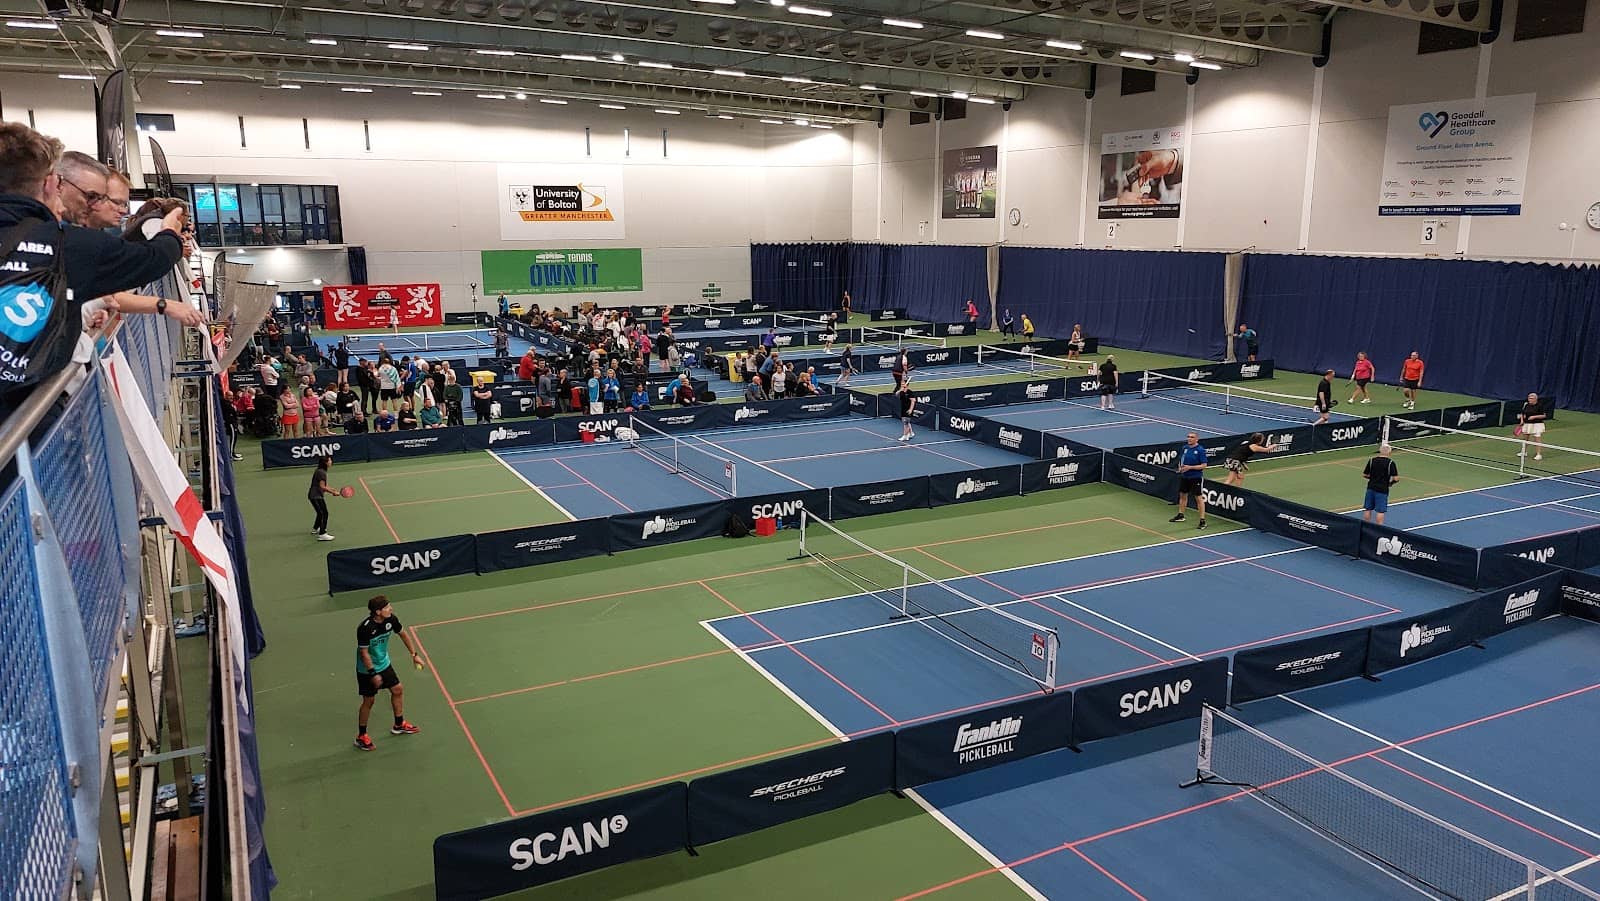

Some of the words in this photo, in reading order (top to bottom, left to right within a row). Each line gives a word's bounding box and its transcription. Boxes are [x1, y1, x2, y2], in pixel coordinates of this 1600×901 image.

[1451, 110, 1484, 120] Goodall
[1450, 118, 1496, 128] Healthcare
[1449, 128, 1476, 136] Group
[535, 189, 580, 200] University
[536, 200, 546, 209] of
[548, 200, 577, 209] Bolton
[1109, 225, 1114, 237] 2
[1425, 227, 1433, 241] 3
[17, 241, 54, 256] AREA
[529, 264, 576, 287] OWN
[583, 264, 599, 285] IT
[1047, 462, 1079, 478] Franklin
[1276, 512, 1329, 530] SKECHERS
[513, 534, 577, 549] SKECHERS
[370, 550, 431, 575] SCAN
[1400, 552, 1417, 561] SHOP
[1401, 549, 1438, 562] PICKLEBALL
[1503, 588, 1540, 615] Franklin
[1505, 607, 1533, 624] PICKLEBALL
[1420, 624, 1452, 638] PICKLEBALL
[1420, 635, 1435, 646] SHOP
[1034, 644, 1043, 656] 10
[1275, 651, 1342, 671] SKECHERS
[1290, 664, 1325, 676] PICKLEBALL
[1119, 681, 1182, 718] SCAN
[953, 716, 1023, 752] Franklin
[959, 738, 1014, 764] PICKLEBALL
[749, 766, 847, 798] SKECHERS
[773, 784, 824, 802] PICKLEBALL
[508, 817, 611, 871] SCAN
